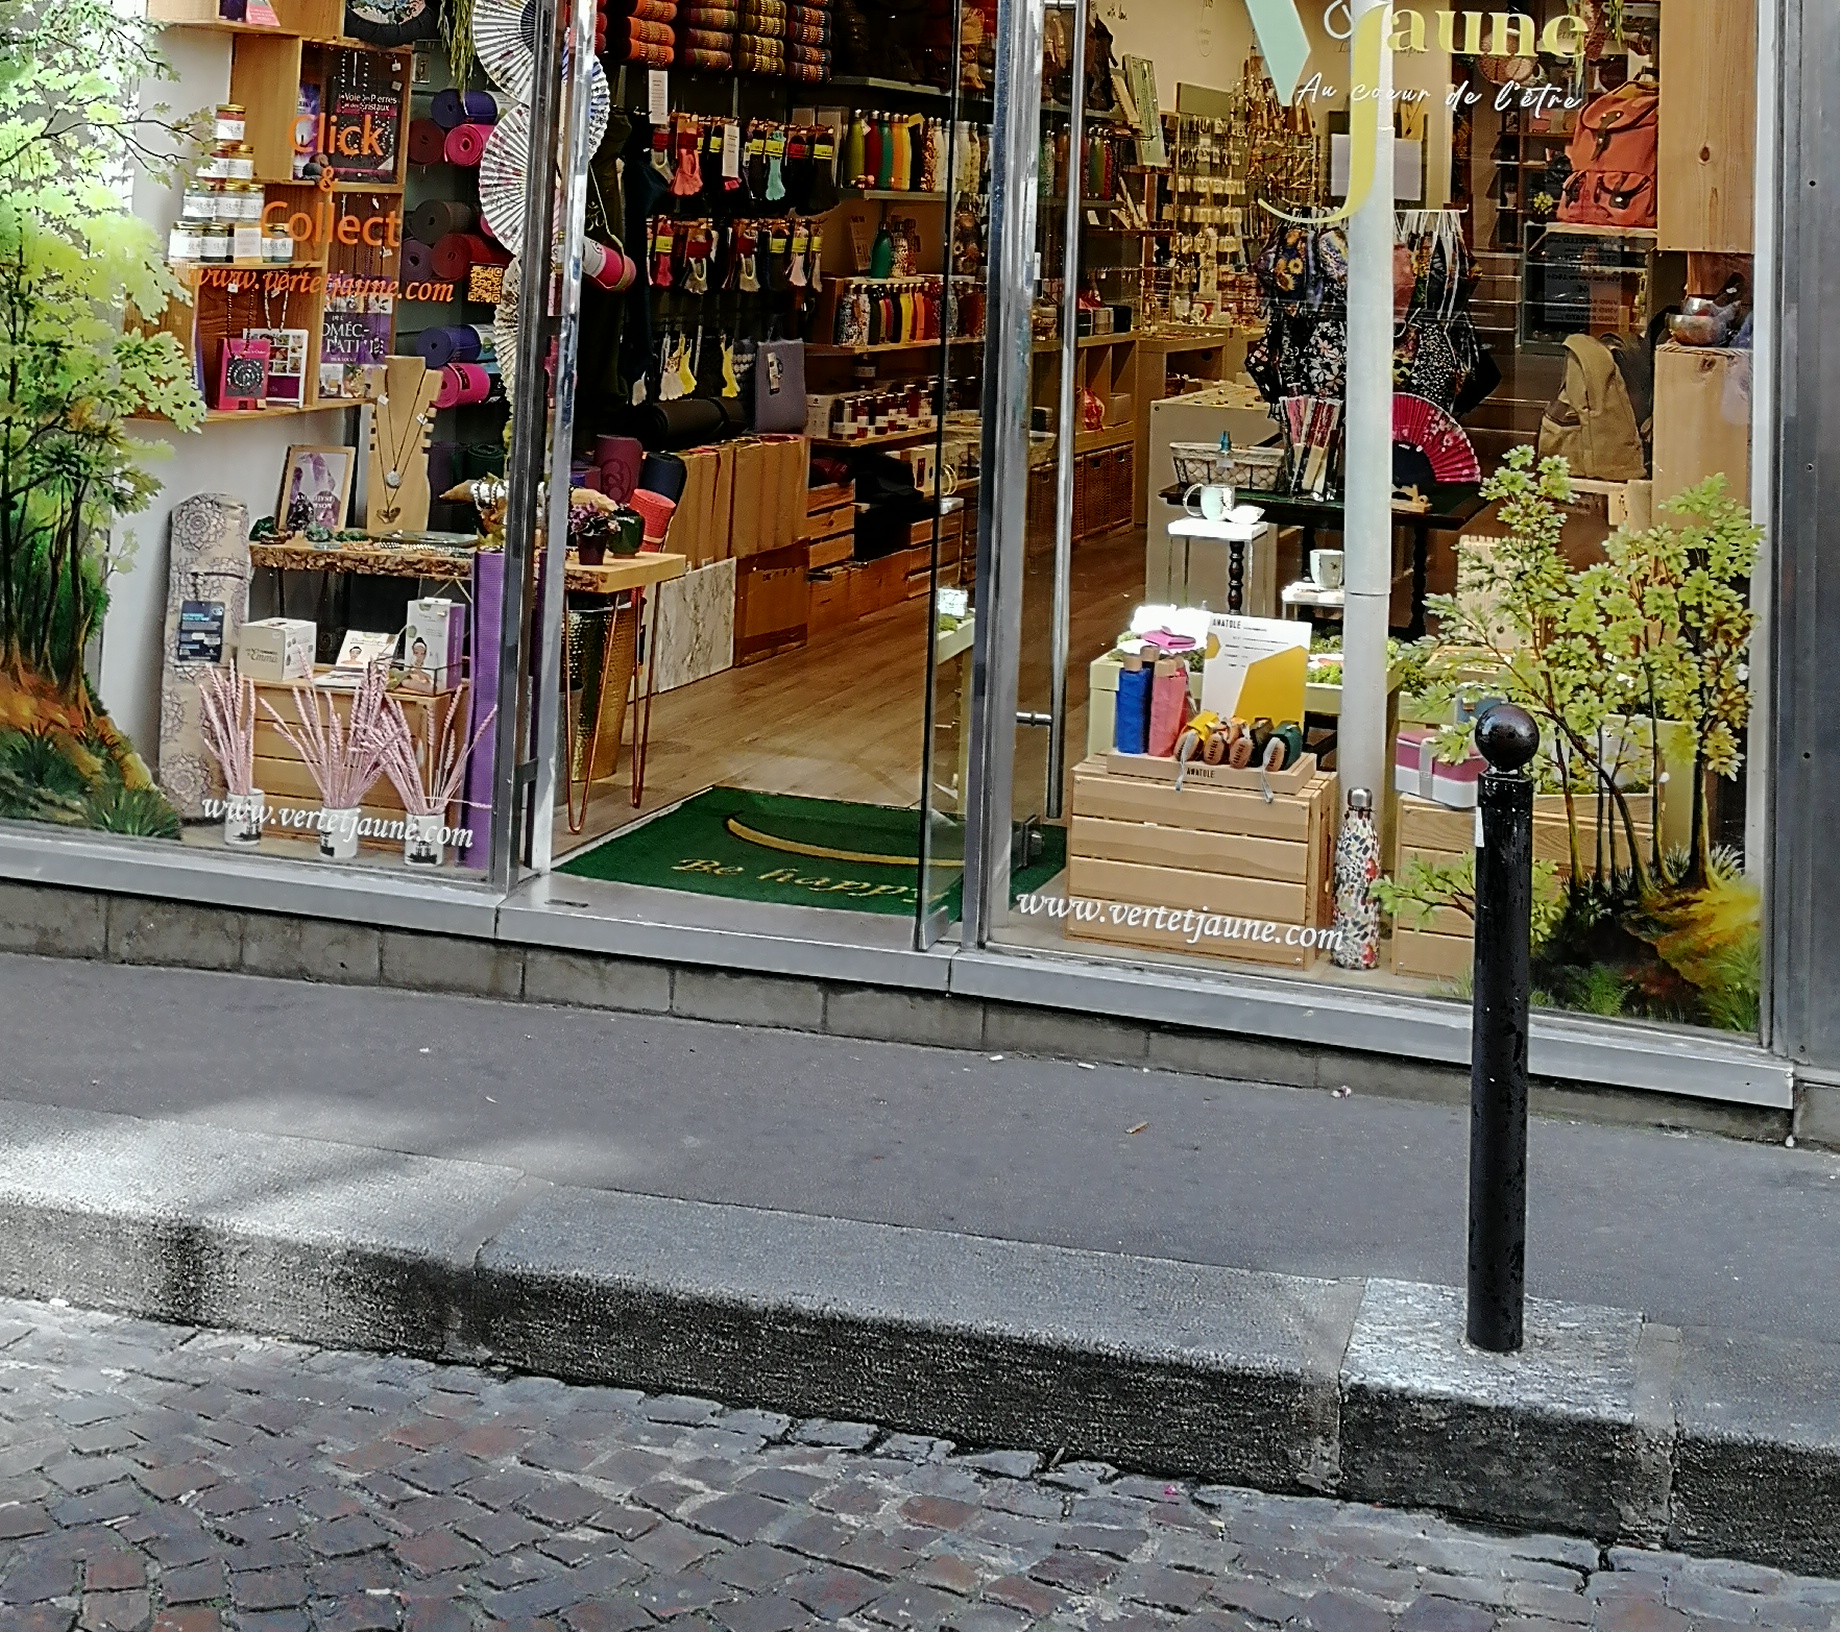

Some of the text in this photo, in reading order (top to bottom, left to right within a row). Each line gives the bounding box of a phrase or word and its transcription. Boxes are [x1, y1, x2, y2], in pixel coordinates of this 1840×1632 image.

[1258, 3, 1590, 223] Jaune
[1297, 72, 1582, 118] Au coeur de l'être
[288, 112, 385, 157] Click
[318, 165, 339, 192] &
[261, 200, 402, 247] Collect
[188, 266, 455, 303] www.vertetjaune.com
[201, 796, 473, 849] www.vertetjaune.com
[1016, 892, 1345, 951] www.vertetjaune.com
